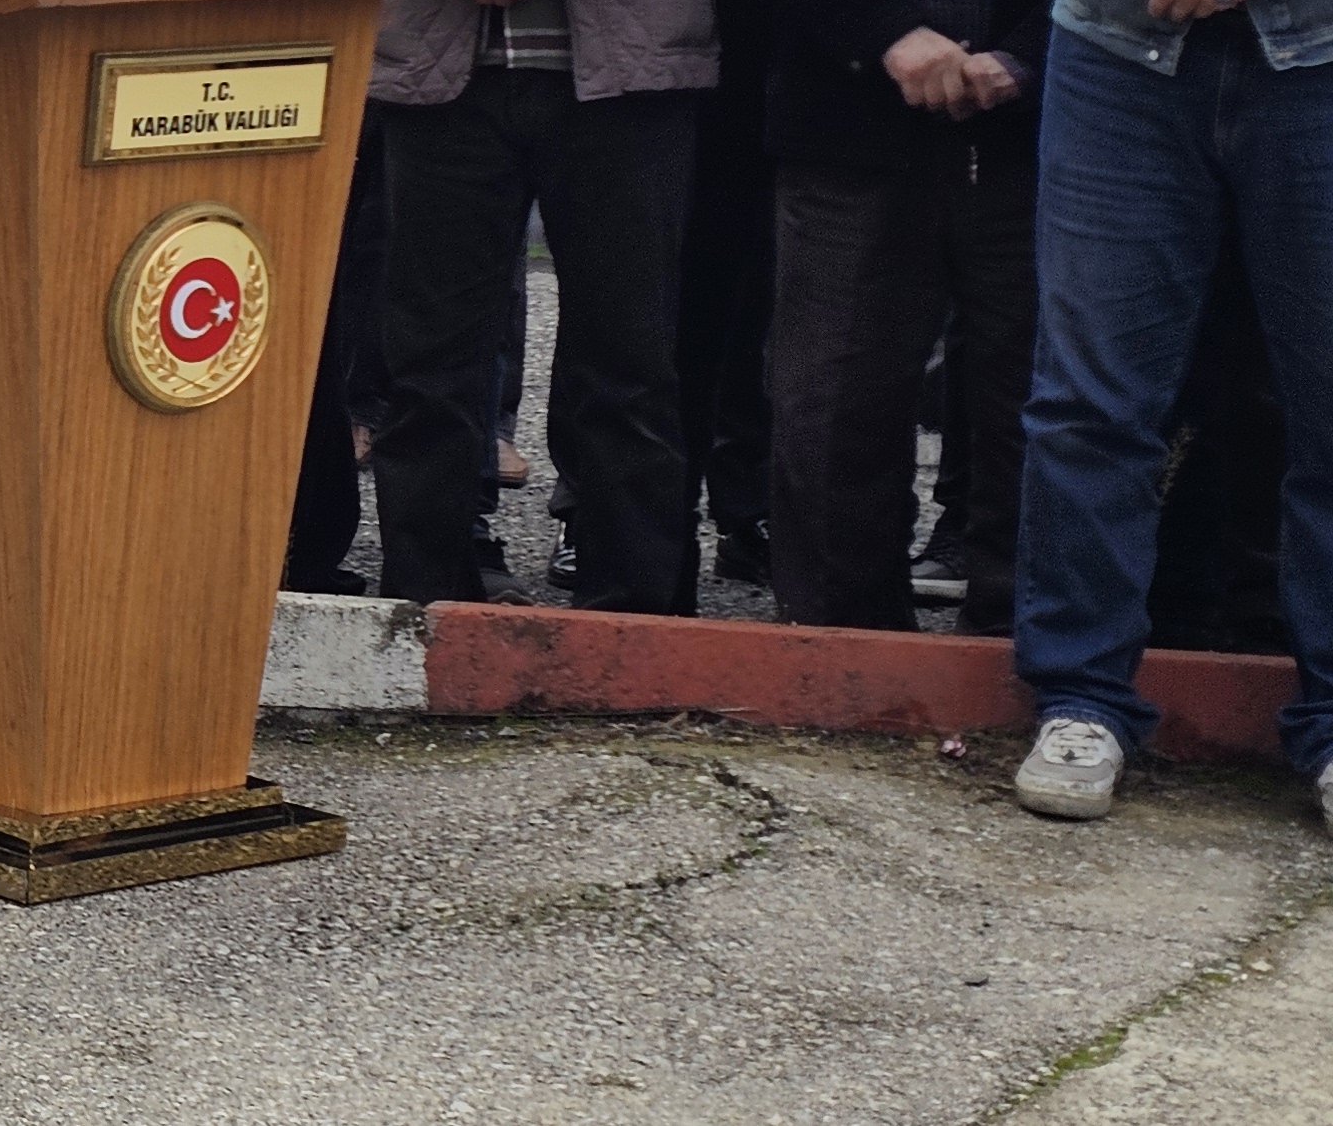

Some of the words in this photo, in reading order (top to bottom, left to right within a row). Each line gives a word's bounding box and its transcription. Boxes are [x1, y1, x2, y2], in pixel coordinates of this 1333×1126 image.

[202, 81, 235, 102] T.C.
[131, 109, 220, 137] KARABÜK
[224, 103, 299, 131] VALİLİĞİ
